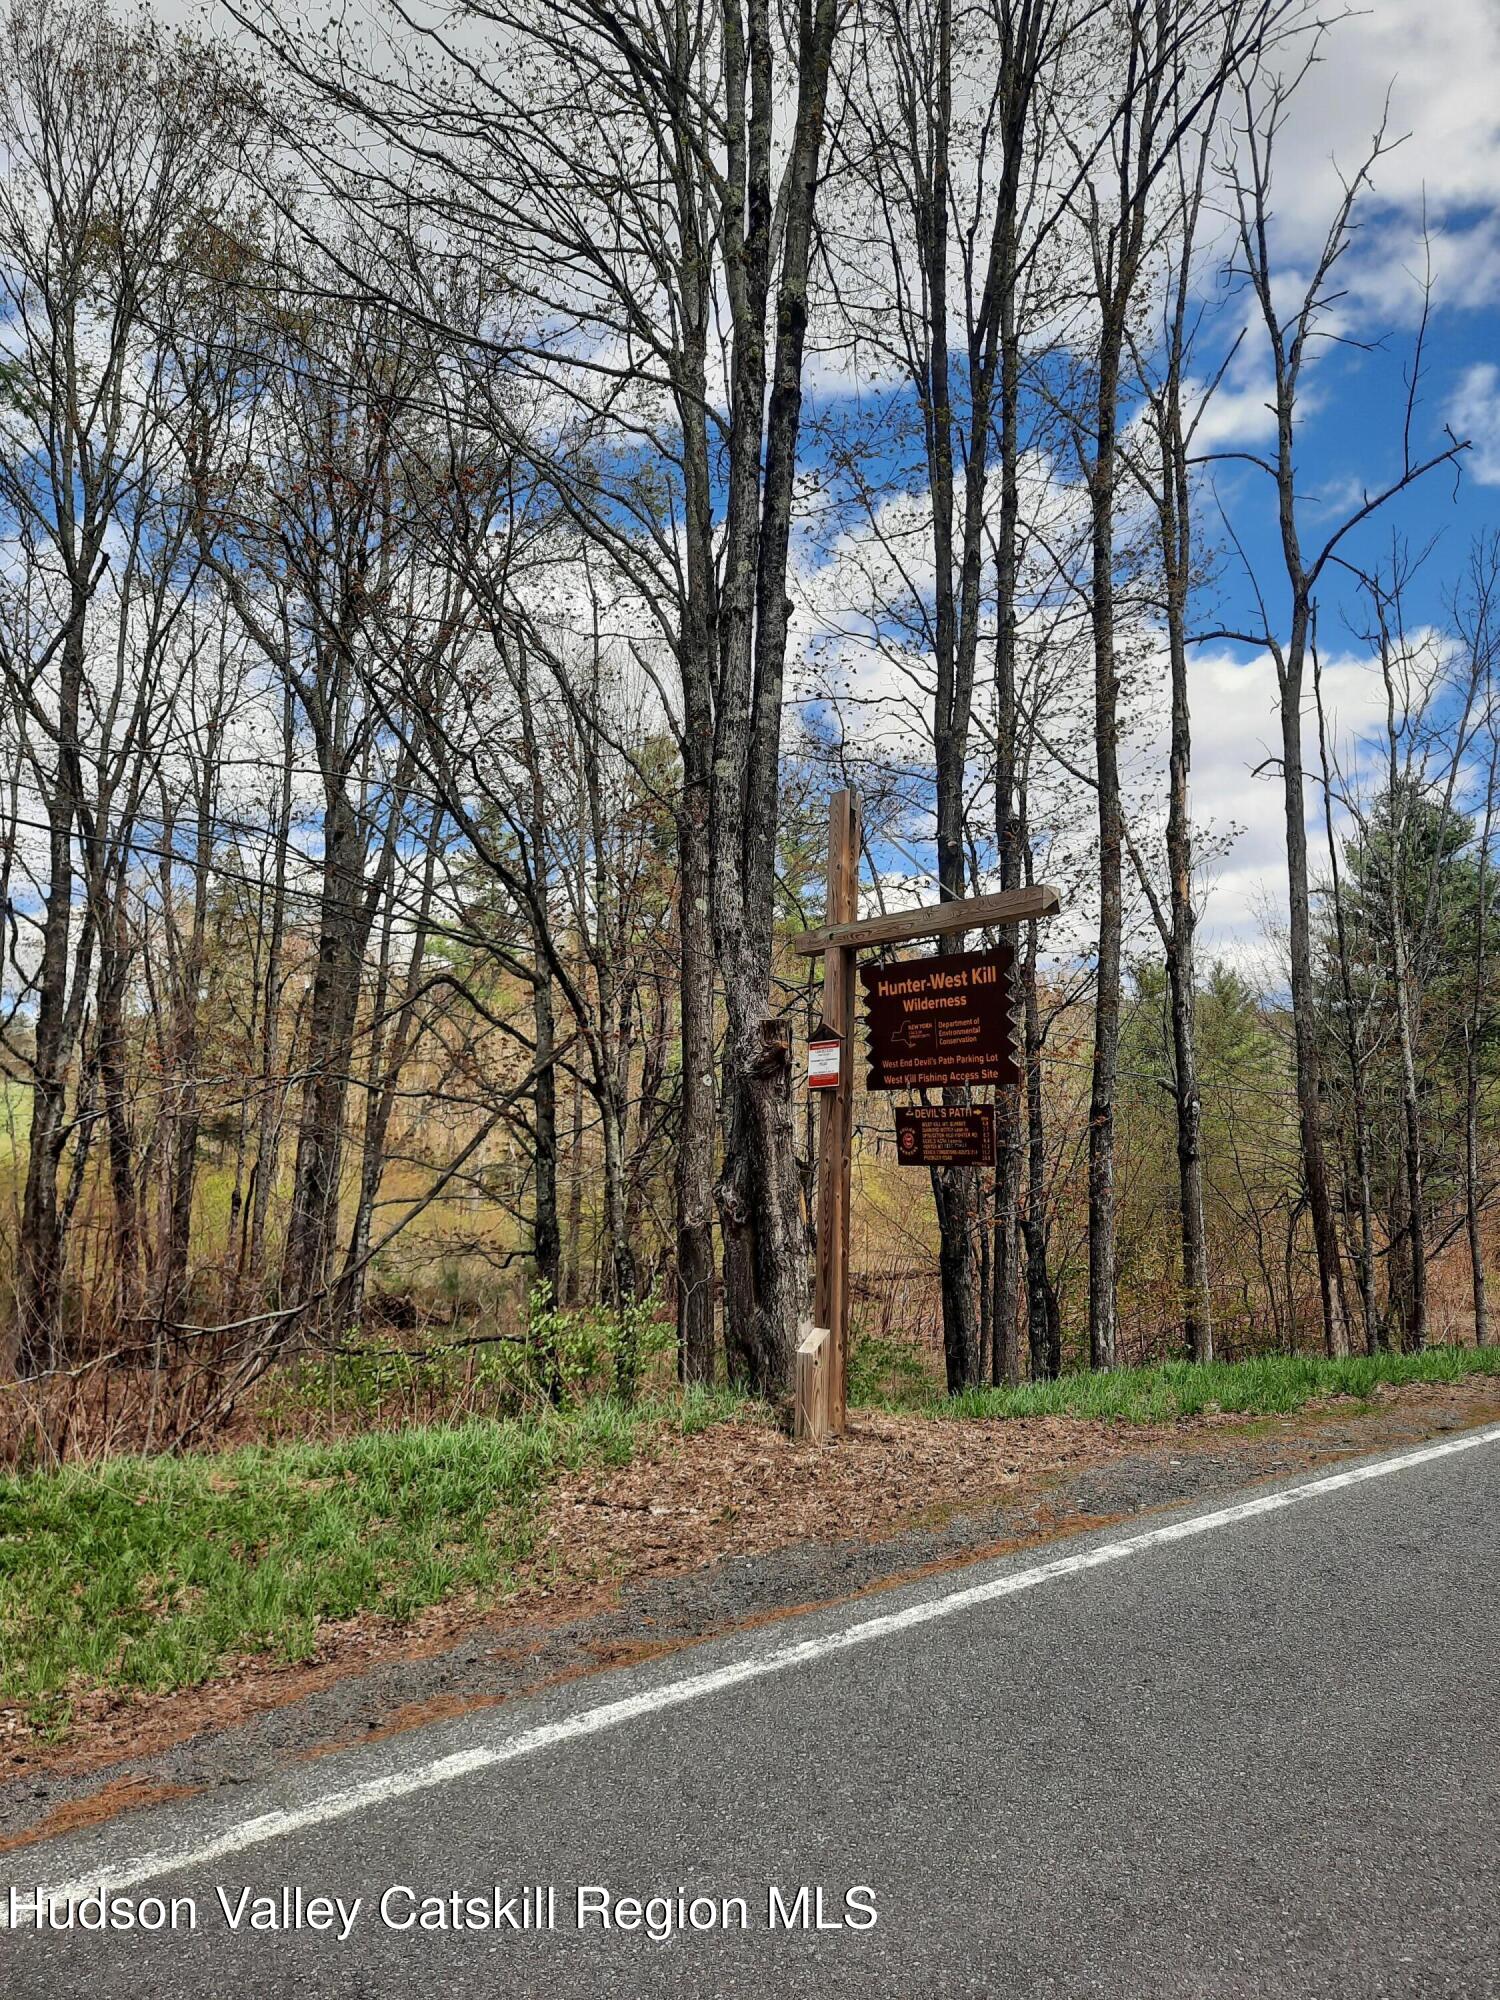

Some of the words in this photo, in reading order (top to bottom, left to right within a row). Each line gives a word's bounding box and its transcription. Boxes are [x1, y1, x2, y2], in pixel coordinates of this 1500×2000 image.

[878, 970, 968, 997] Hunter-West
[971, 966, 997, 985] Kill
[903, 995, 967, 1012] Wilderness
[938, 1019, 973, 1029] Department
[938, 1026, 981, 1037] Environmental
[939, 1036, 977, 1045] Conservation
[882, 1060, 899, 1069] West
[900, 1058, 913, 1067] End
[914, 1057, 937, 1066] Devil's
[938, 1055, 955, 1065] Path
[956, 1054, 984, 1065] Parking
[985, 1053, 999, 1062] Lot
[883, 1075, 903, 1085] West
[904, 1073, 917, 1084] Kill
[918, 1072, 948, 1084] Fishing
[950, 1071, 979, 1081] Access
[981, 1069, 999, 1079] Site
[915, 1108, 946, 1118] DEVIL'S
[949, 1107, 972, 1118] PATH
